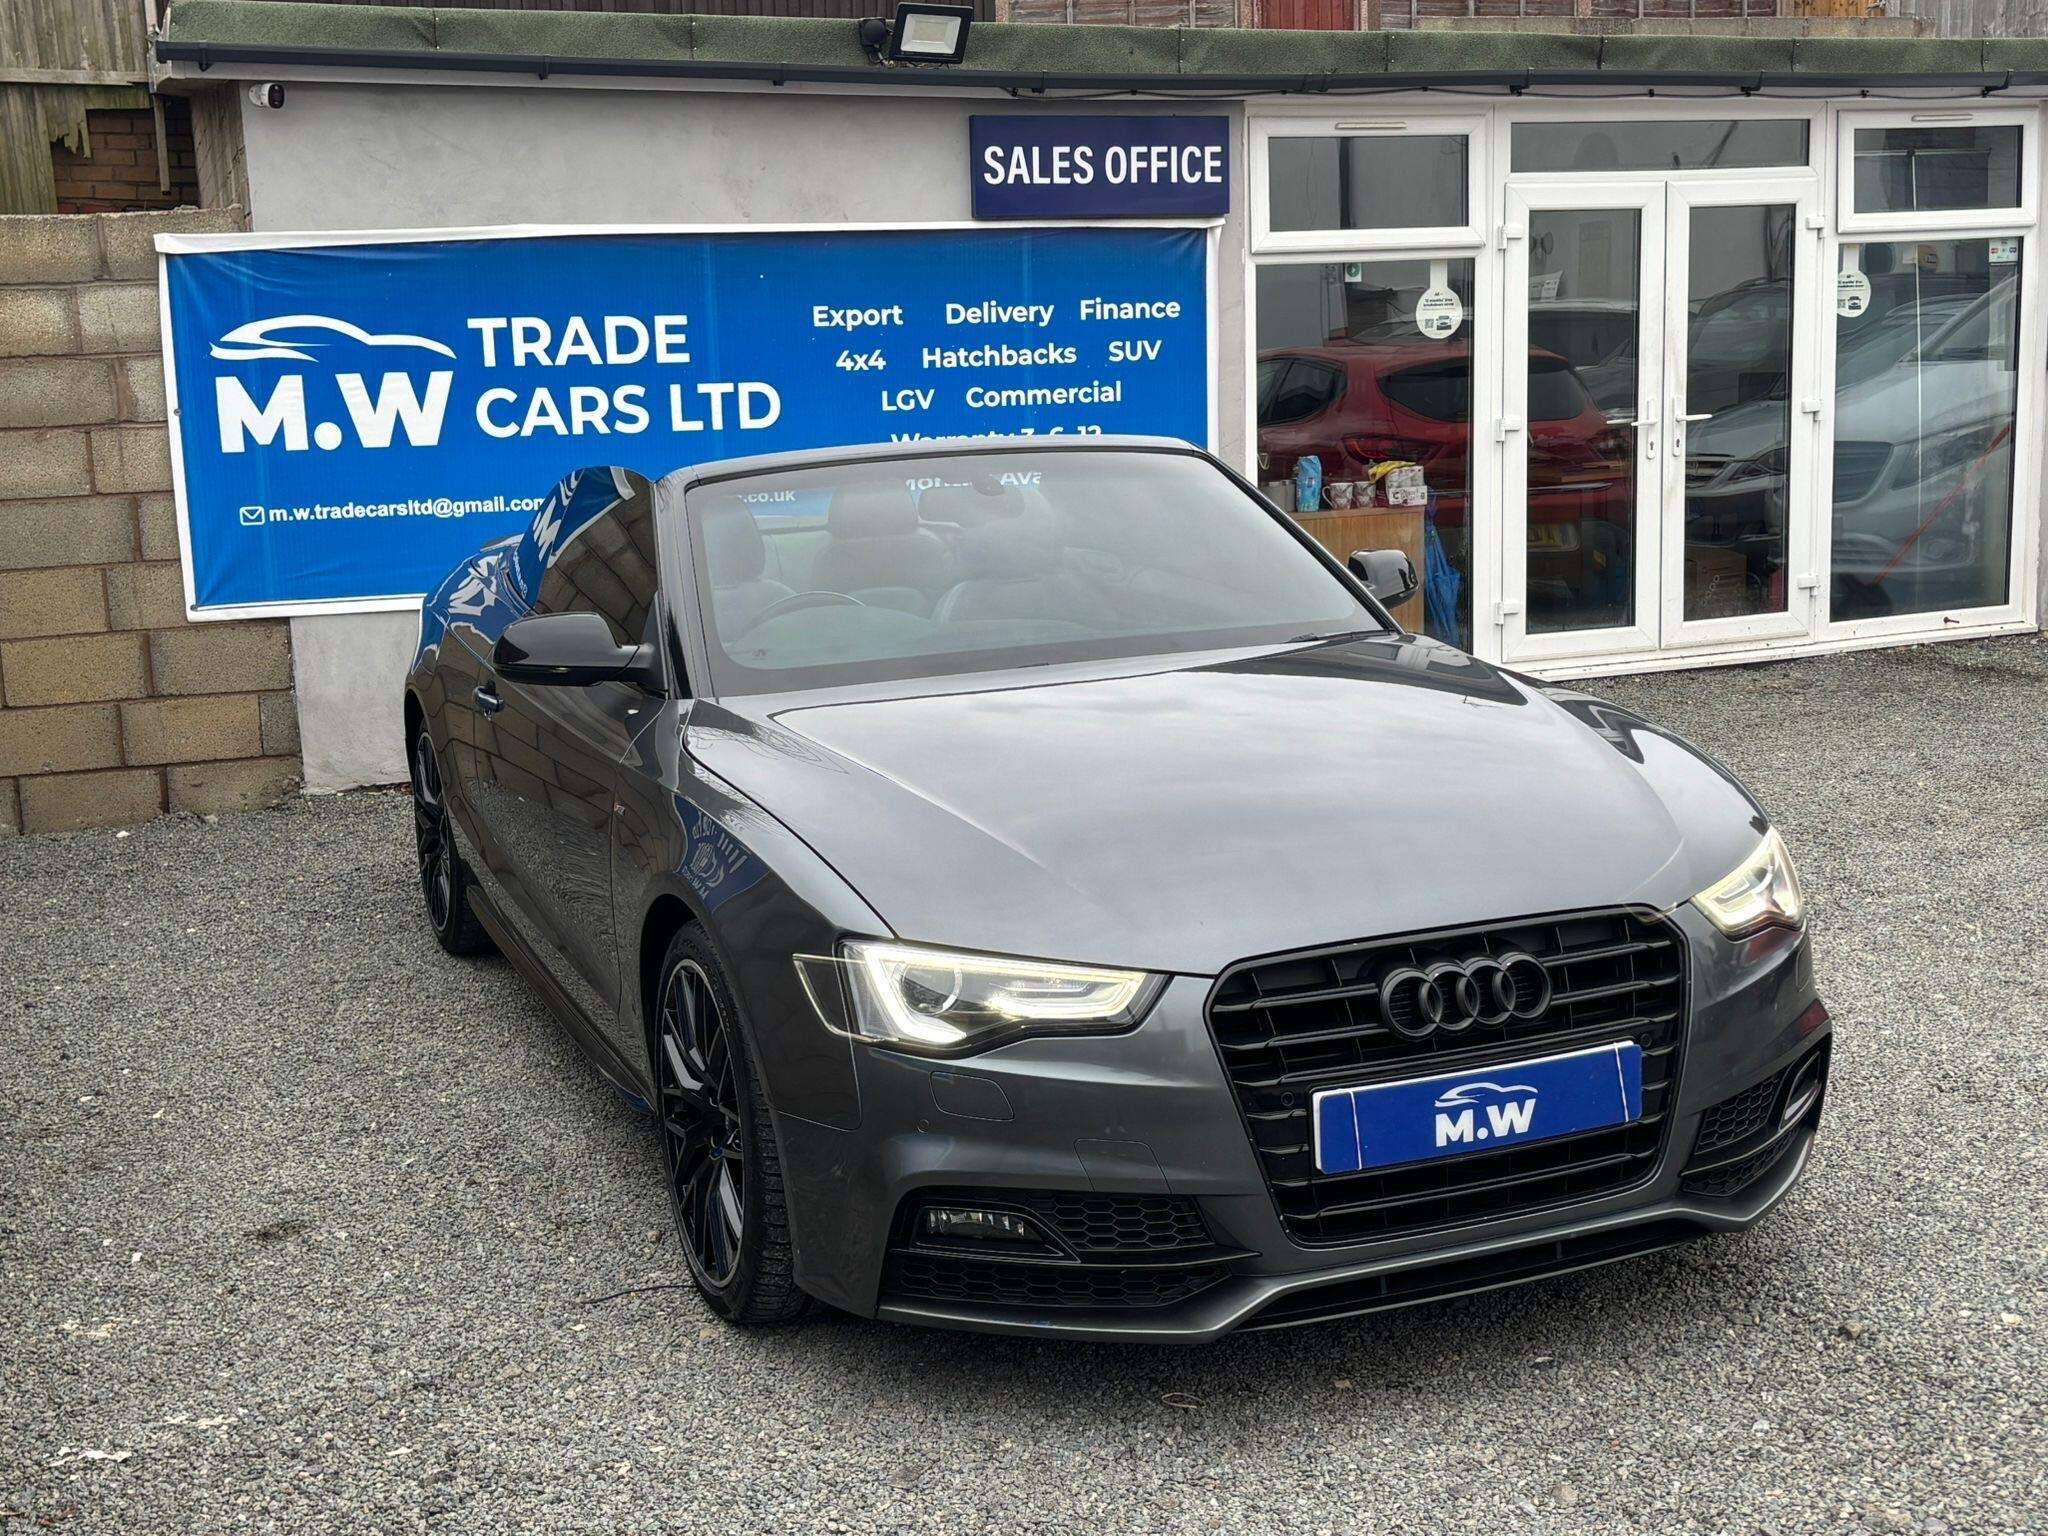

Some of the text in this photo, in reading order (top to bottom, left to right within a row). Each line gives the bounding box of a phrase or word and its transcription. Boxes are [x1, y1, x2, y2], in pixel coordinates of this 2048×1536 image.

[984, 145, 1223, 185] SALES OFFICE
[813, 298, 1181, 331] Export Delivery Finance
[467, 314, 691, 367] TRADE
[836, 340, 1162, 371] 4x4 Hatchbacks SUV
[215, 371, 454, 453] M.W
[475, 382, 781, 437] CARS LTD
[881, 381, 1122, 411] LGV Commercial
[1435, 1098, 1537, 1148] M.W
